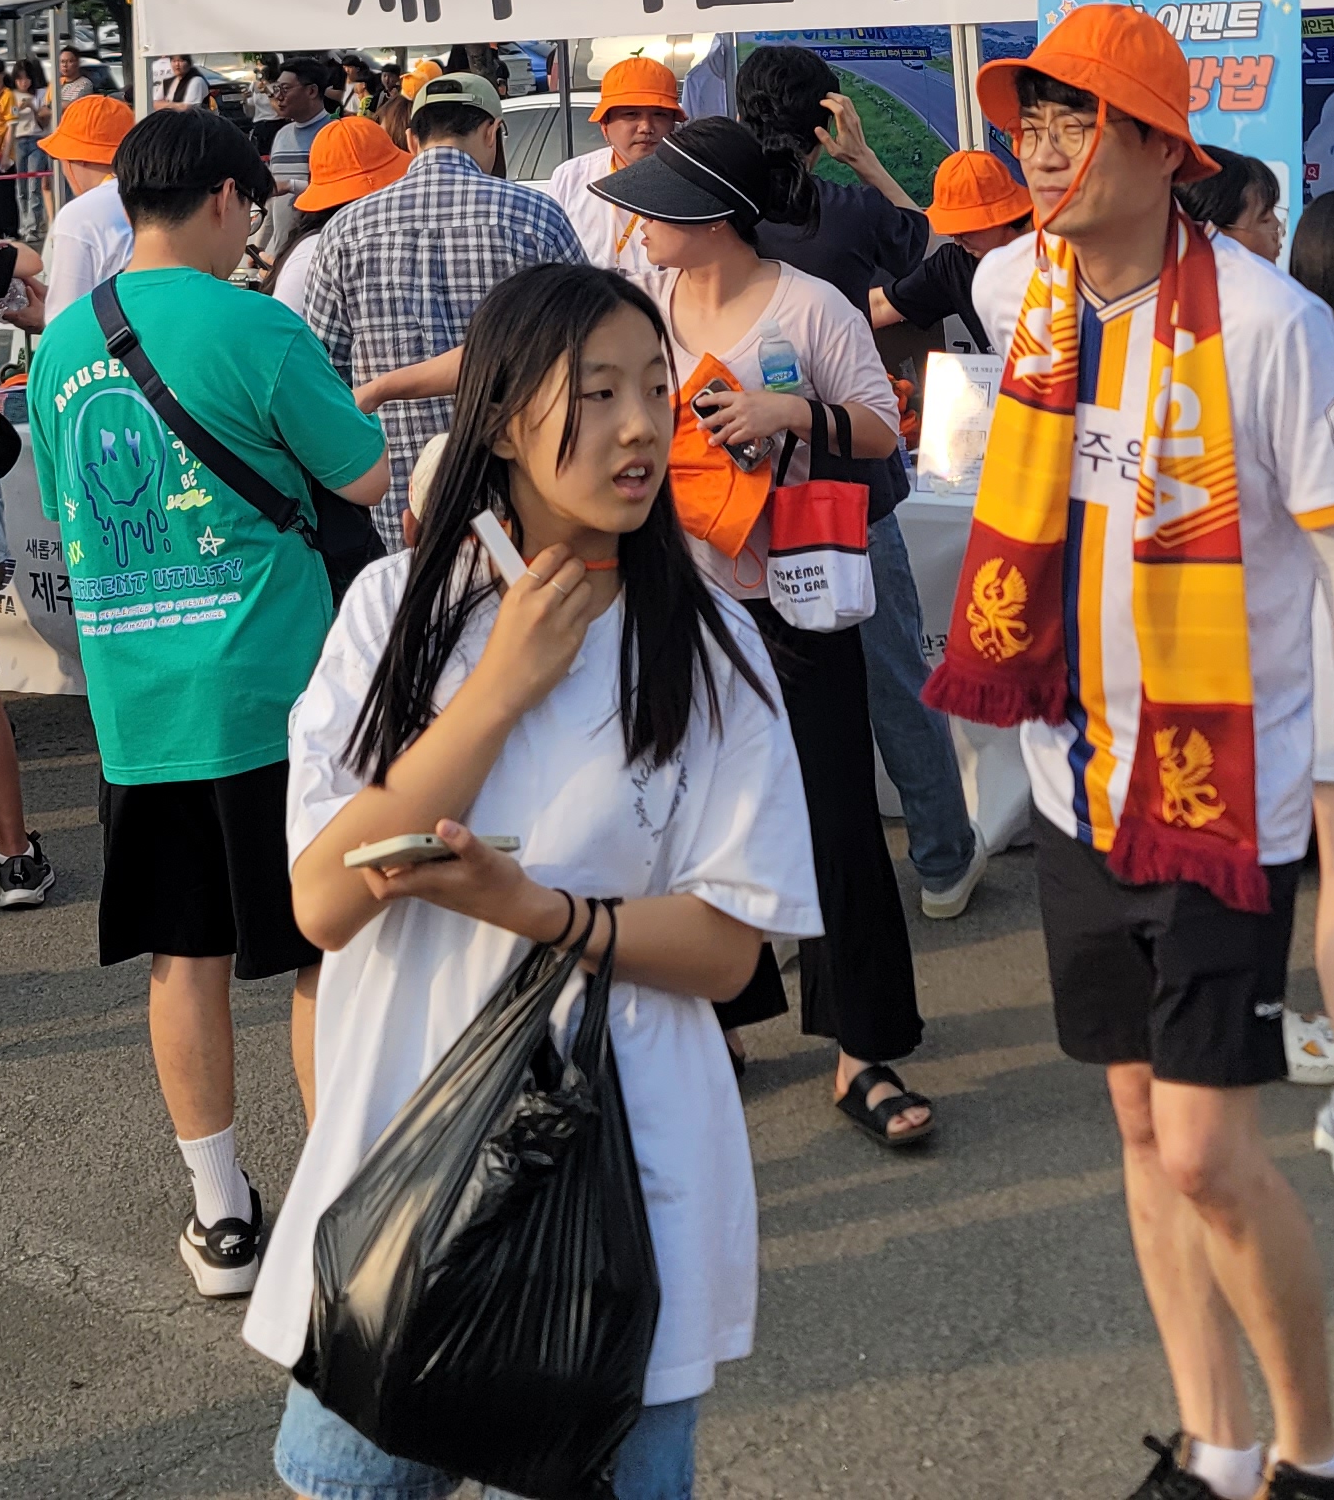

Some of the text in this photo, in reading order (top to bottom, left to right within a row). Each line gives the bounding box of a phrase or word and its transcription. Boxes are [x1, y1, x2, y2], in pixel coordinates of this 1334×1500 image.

[1156, 1, 1263, 42] 이벤트
[1302, 43, 1330, 64] 스로
[1186, 55, 1275, 112] 방법
[1074, 429, 1143, 482] 주은
[180, 468, 197, 490] BE
[25, 538, 63, 562] 새롭게
[28, 571, 74, 616] 제주
[71, 557, 244, 602] RRENT UTILITY
